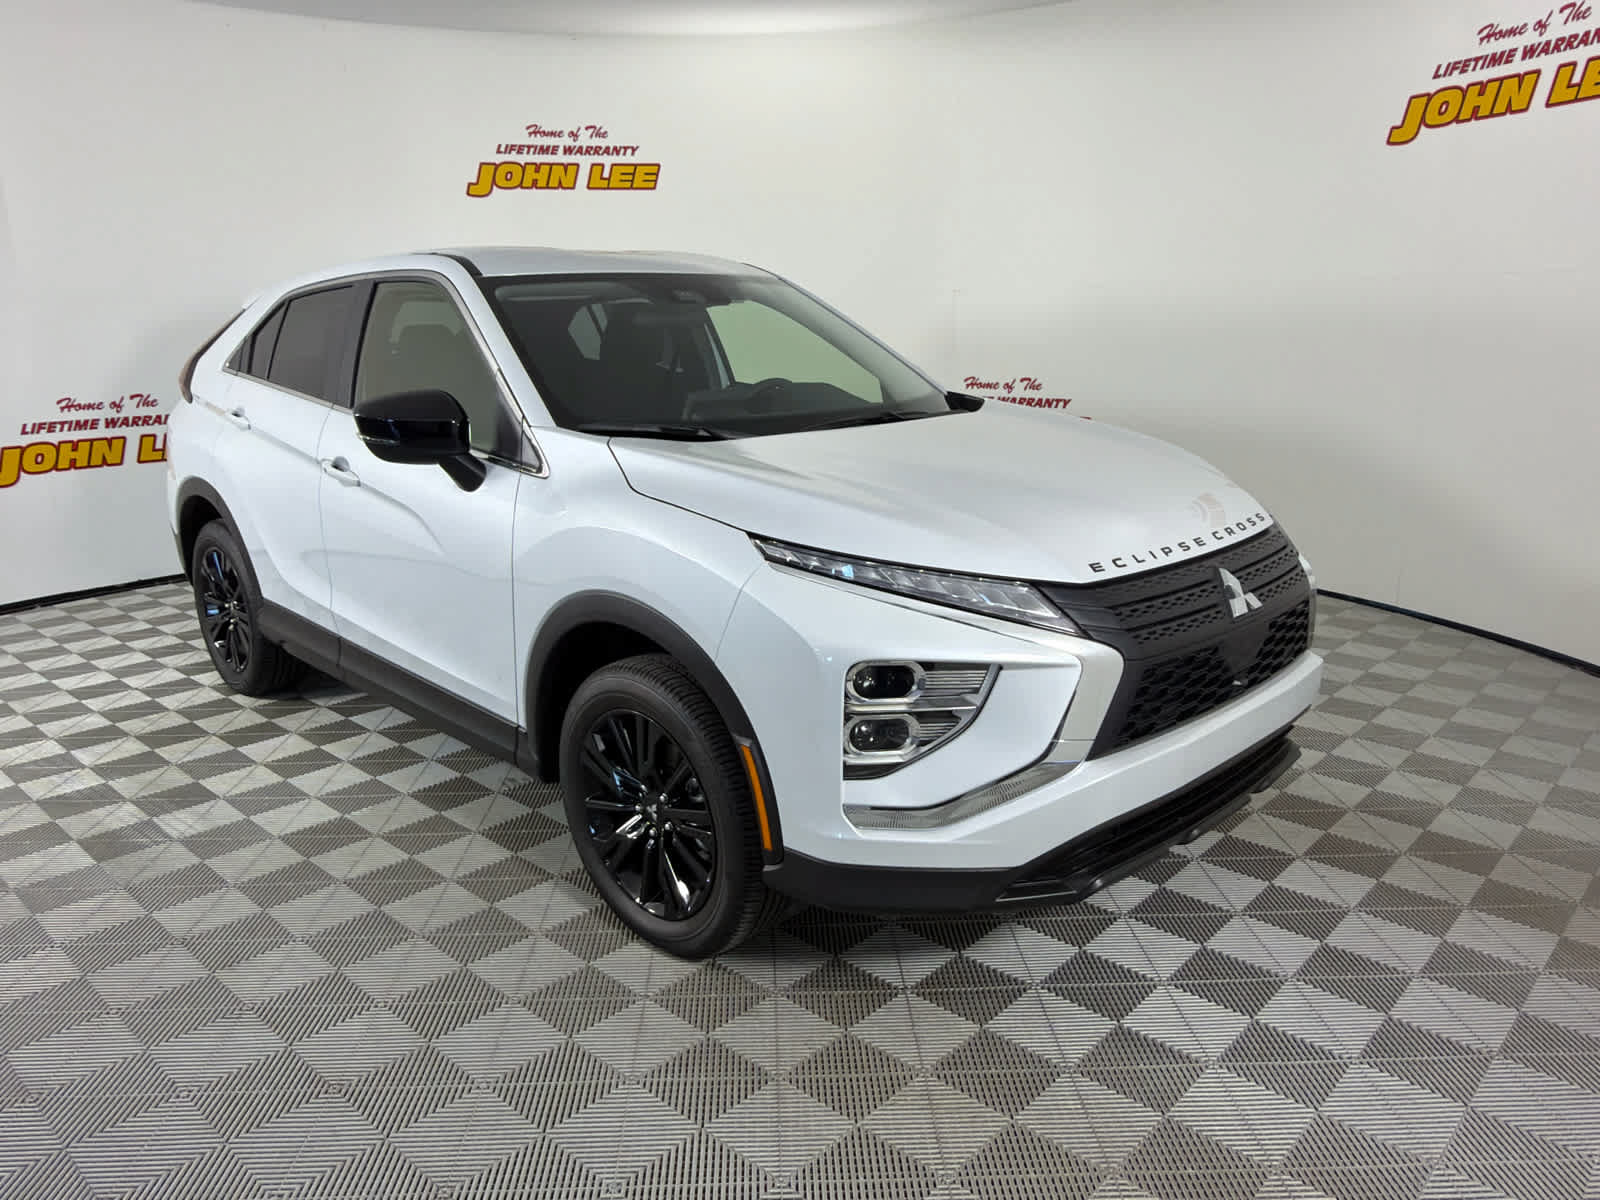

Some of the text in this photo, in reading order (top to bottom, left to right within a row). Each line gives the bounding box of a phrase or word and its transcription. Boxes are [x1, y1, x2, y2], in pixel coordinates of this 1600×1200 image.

[1477, 0, 1592, 45] Home of The
[1432, 47, 1519, 79] LIFETIME
[1386, 68, 1541, 145] JOHN
[525, 124, 608, 142] Home of The
[496, 143, 640, 156] LIFETIME WARRANTY
[466, 161, 661, 198] JOHN LEE
[963, 376, 1042, 394] Home of The
[56, 393, 159, 413] Home of The
[20, 418, 100, 435] LIFETIME
[0, 436, 127, 488] JOHN
[1088, 512, 1265, 573] ECLIPSE CROSS
